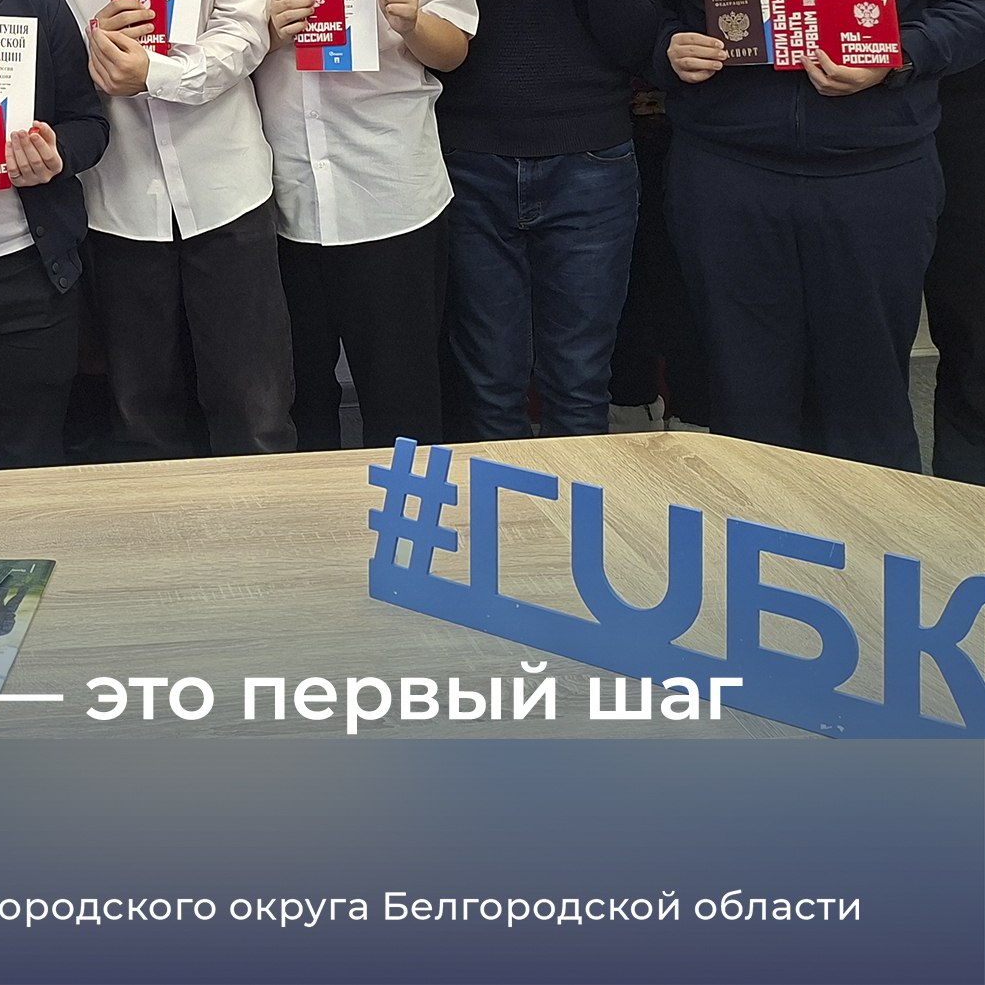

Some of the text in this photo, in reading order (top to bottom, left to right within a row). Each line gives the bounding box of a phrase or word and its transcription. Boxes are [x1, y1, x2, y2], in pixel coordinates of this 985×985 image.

[306, 21, 343, 32] ЖДАНЕ
[789, 11, 804, 66] ТО БЫТЬ
[840, 32, 860, 42] МЫ
[726, 47, 758, 58] АСПОРТ
[775, 33, 790, 66] ЕСЛИ
[841, 43, 898, 54] ГРАЖДАНЕ
[842, 54, 890, 64] РОССИИ!
